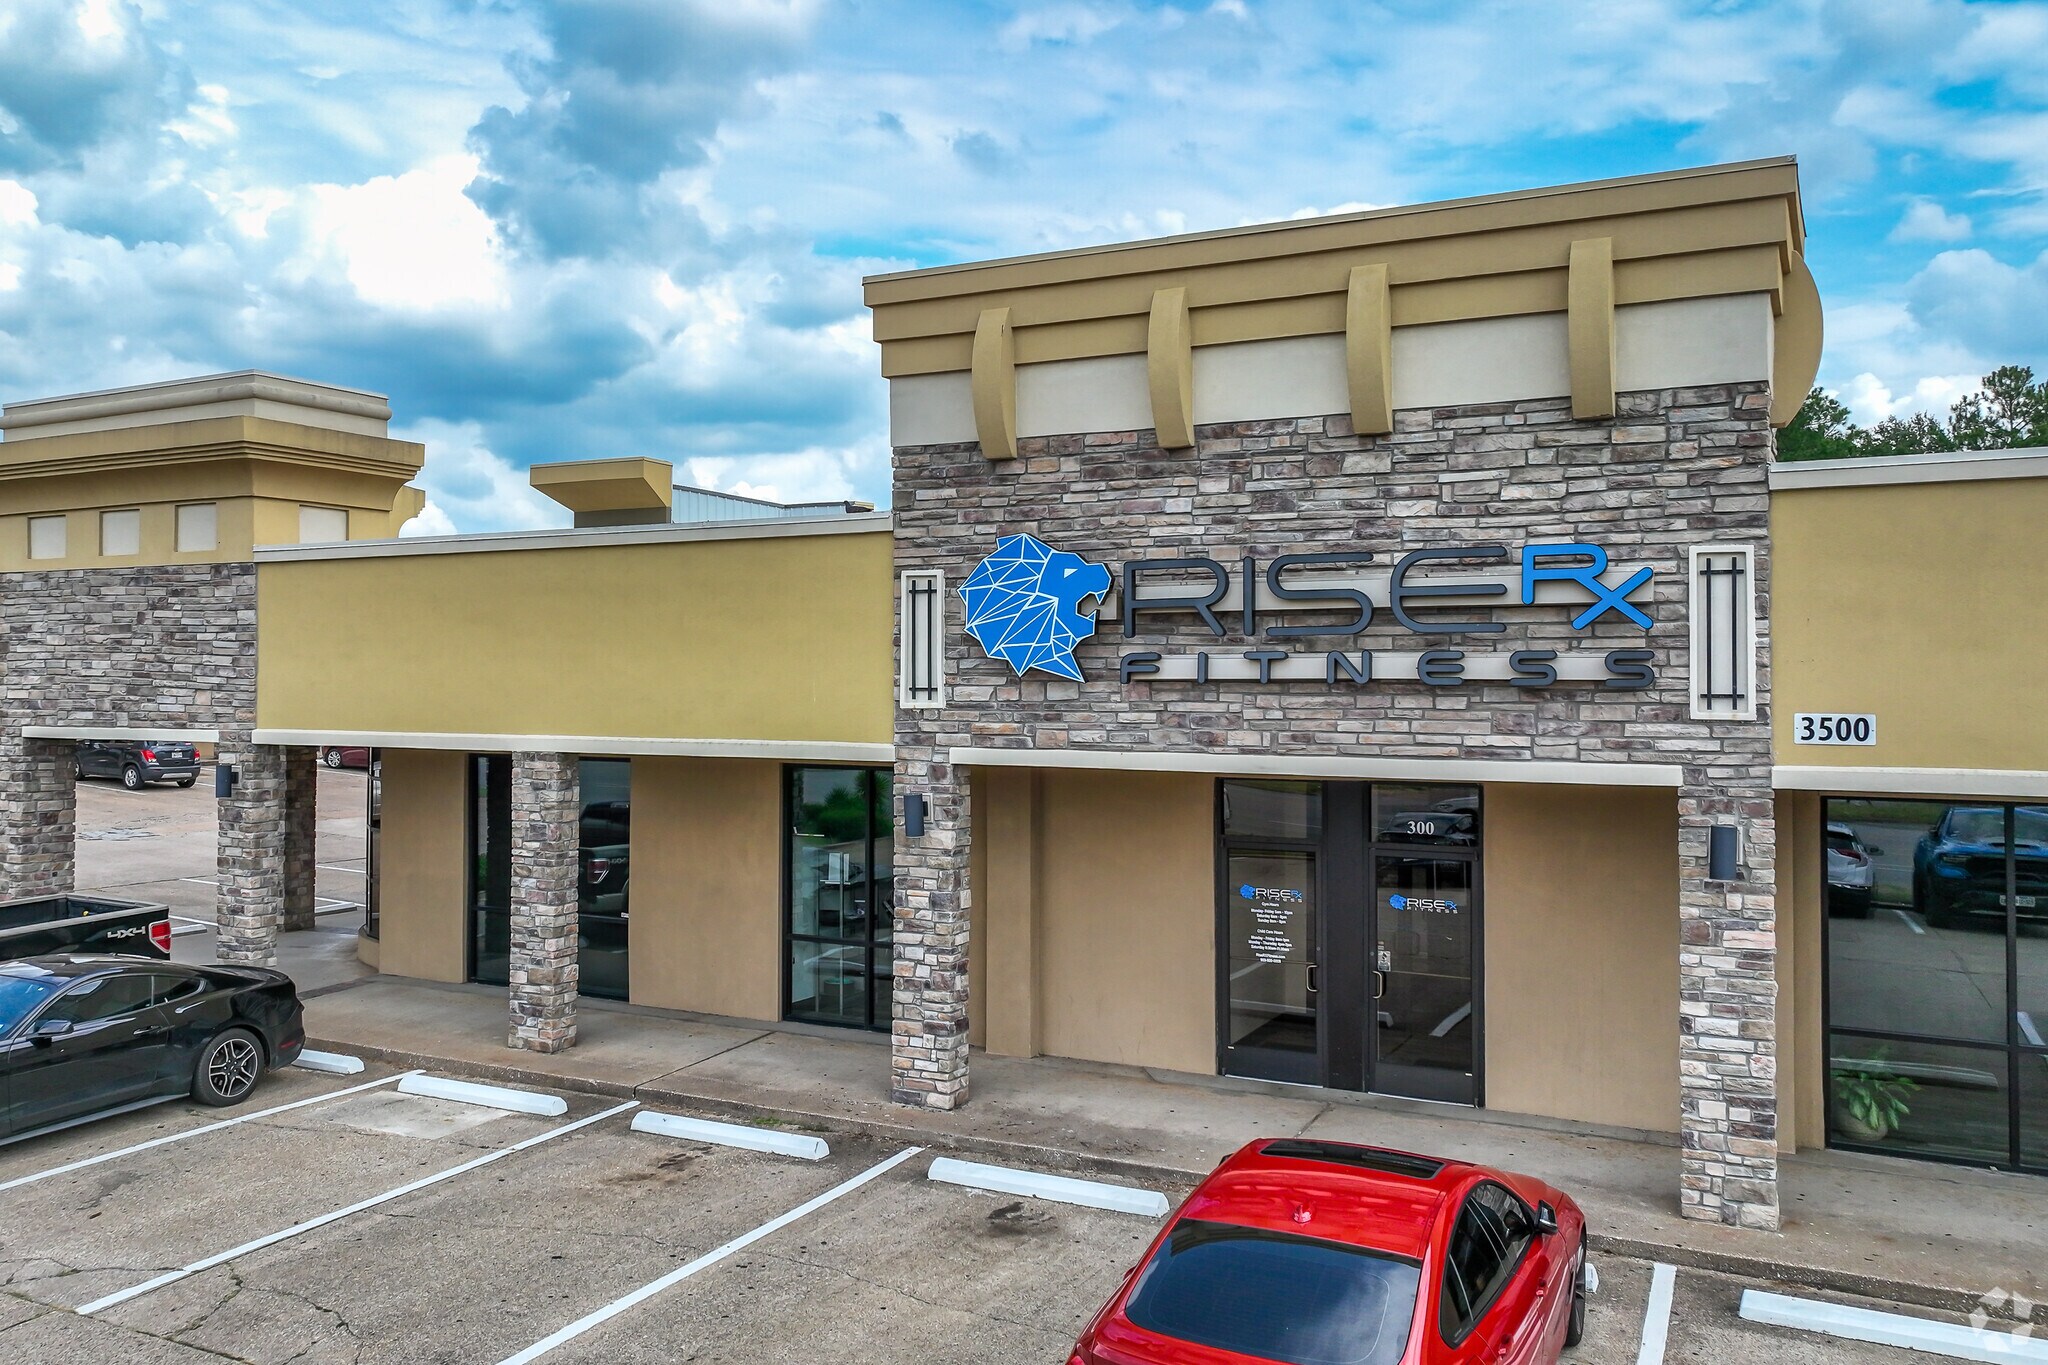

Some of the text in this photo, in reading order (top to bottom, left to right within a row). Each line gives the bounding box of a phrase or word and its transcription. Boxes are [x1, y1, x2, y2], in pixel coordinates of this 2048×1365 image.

[1120, 649, 1655, 688] FITNESS
[1800, 716, 1870, 742] 3500
[1407, 820, 1435, 835] 300
[1406, 906, 1458, 914] FITNESS
